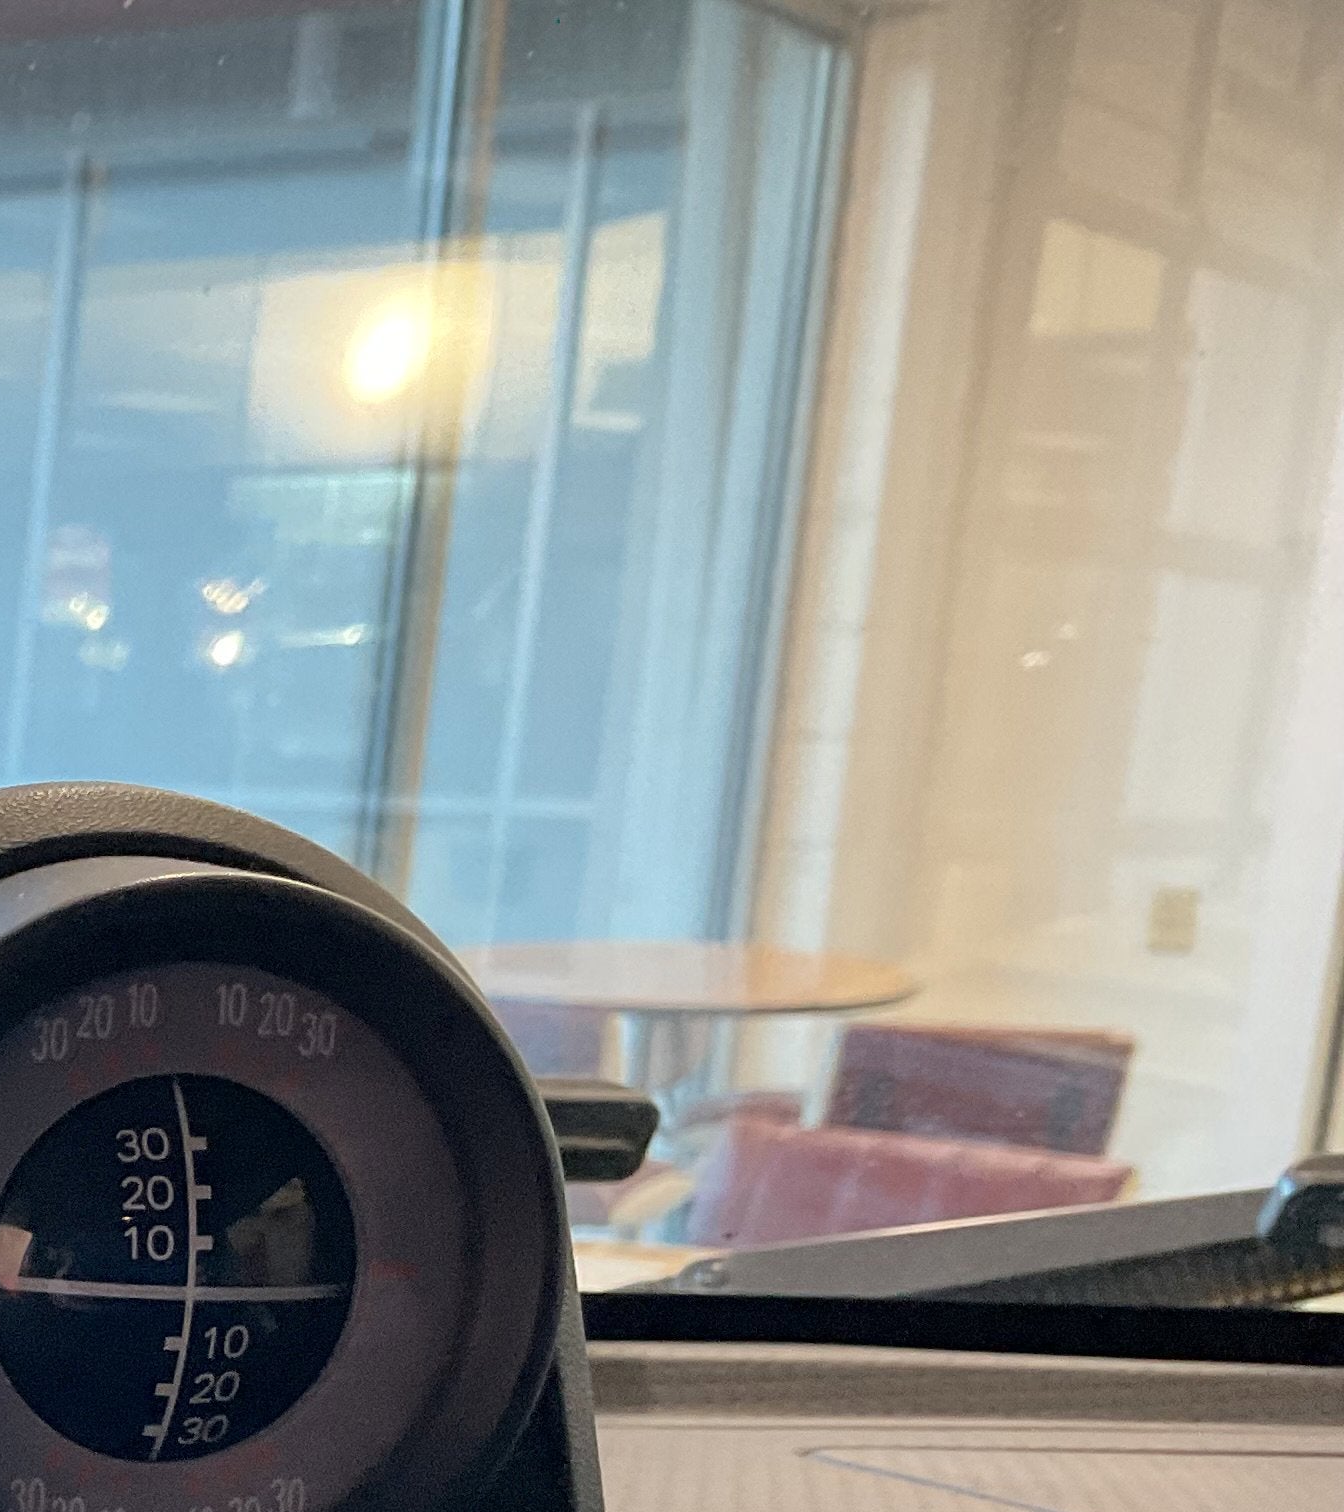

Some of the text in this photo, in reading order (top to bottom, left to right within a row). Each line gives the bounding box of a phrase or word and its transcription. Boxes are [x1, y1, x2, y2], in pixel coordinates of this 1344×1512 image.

[31, 983, 158, 1063] 30 20 10
[216, 983, 337, 1058] 10 20 30
[115, 1127, 170, 1163] 30
[120, 1174, 175, 1211] 20
[123, 1224, 175, 1261] 10
[203, 1325, 250, 1359] 10
[188, 1370, 241, 1404] 20
[176, 1416, 230, 1445] 30
